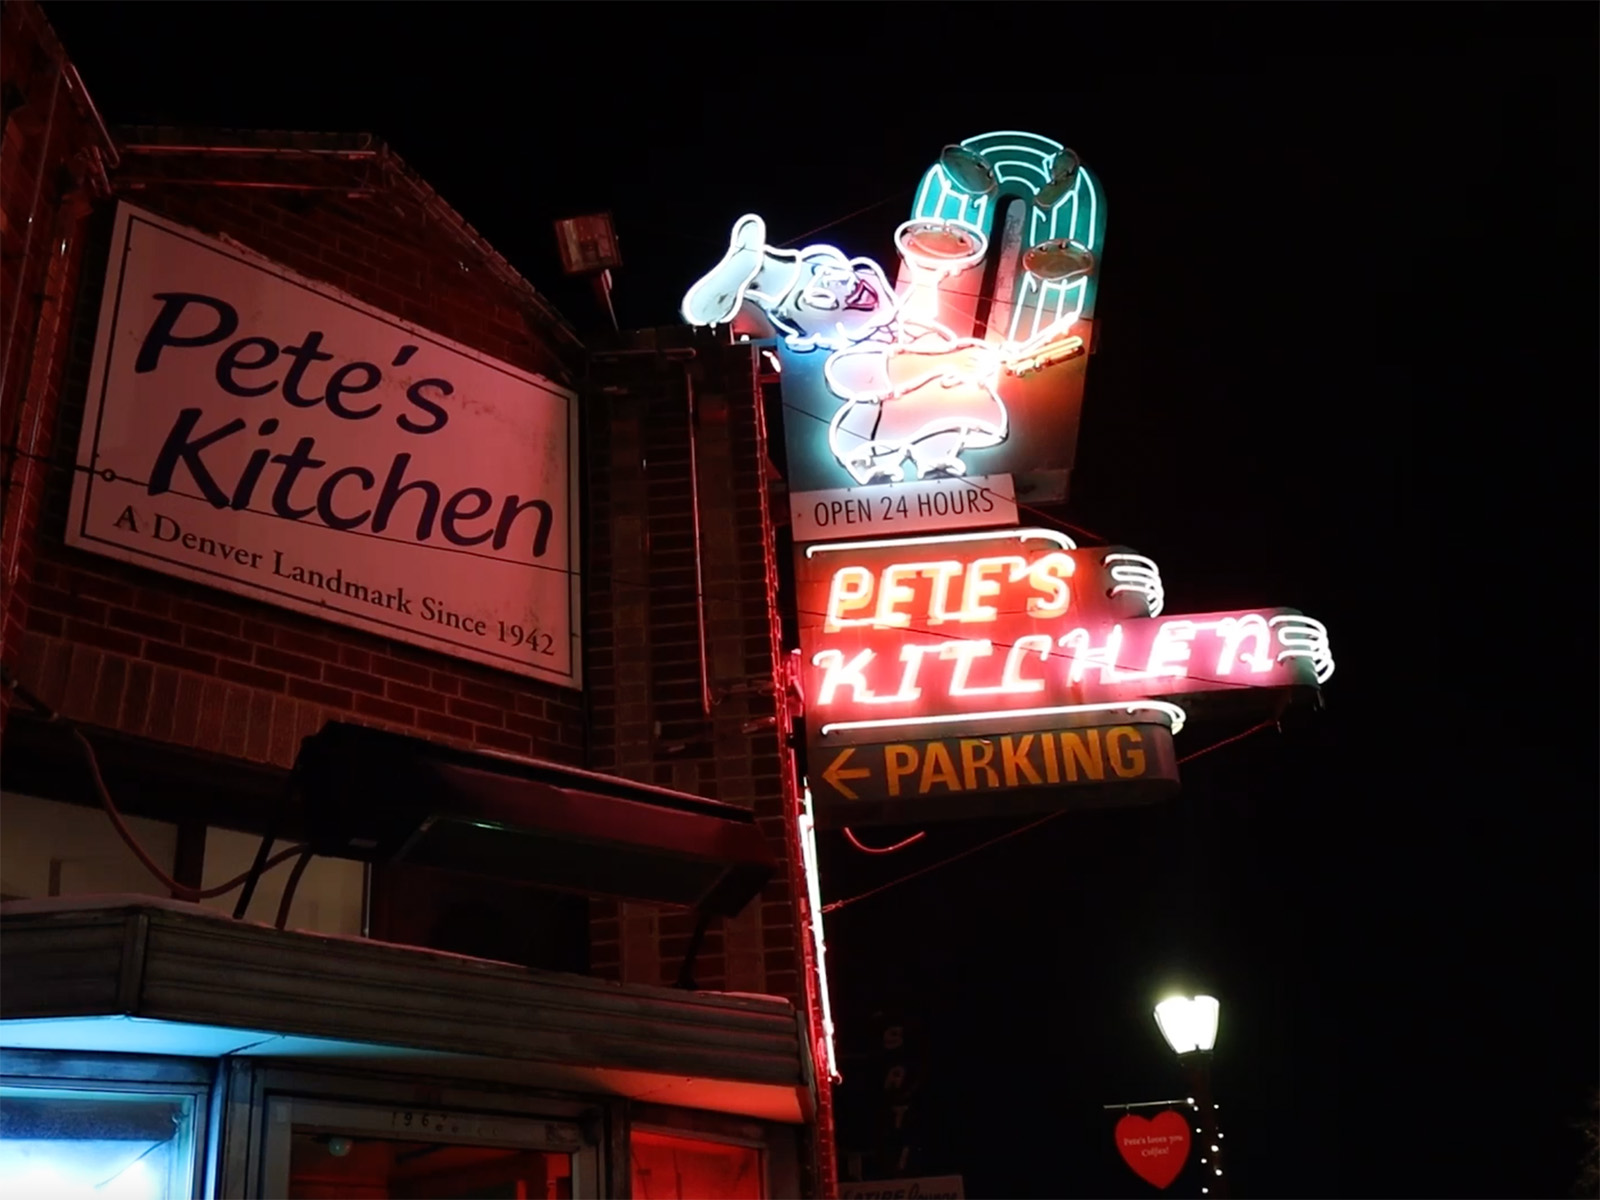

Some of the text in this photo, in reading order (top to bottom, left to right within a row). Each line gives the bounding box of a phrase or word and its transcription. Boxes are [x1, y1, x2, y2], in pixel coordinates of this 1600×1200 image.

[135, 292, 454, 434] Pete's
[147, 408, 553, 557] Kitchen
[813, 487, 995, 527] OPEN 24 HOURS
[113, 505, 555, 656] A Denver Landmark Since 1942
[823, 551, 1077, 634] PETE'S
[811, 613, 1276, 706] KITCHEN
[883, 725, 1146, 797] PARKING
